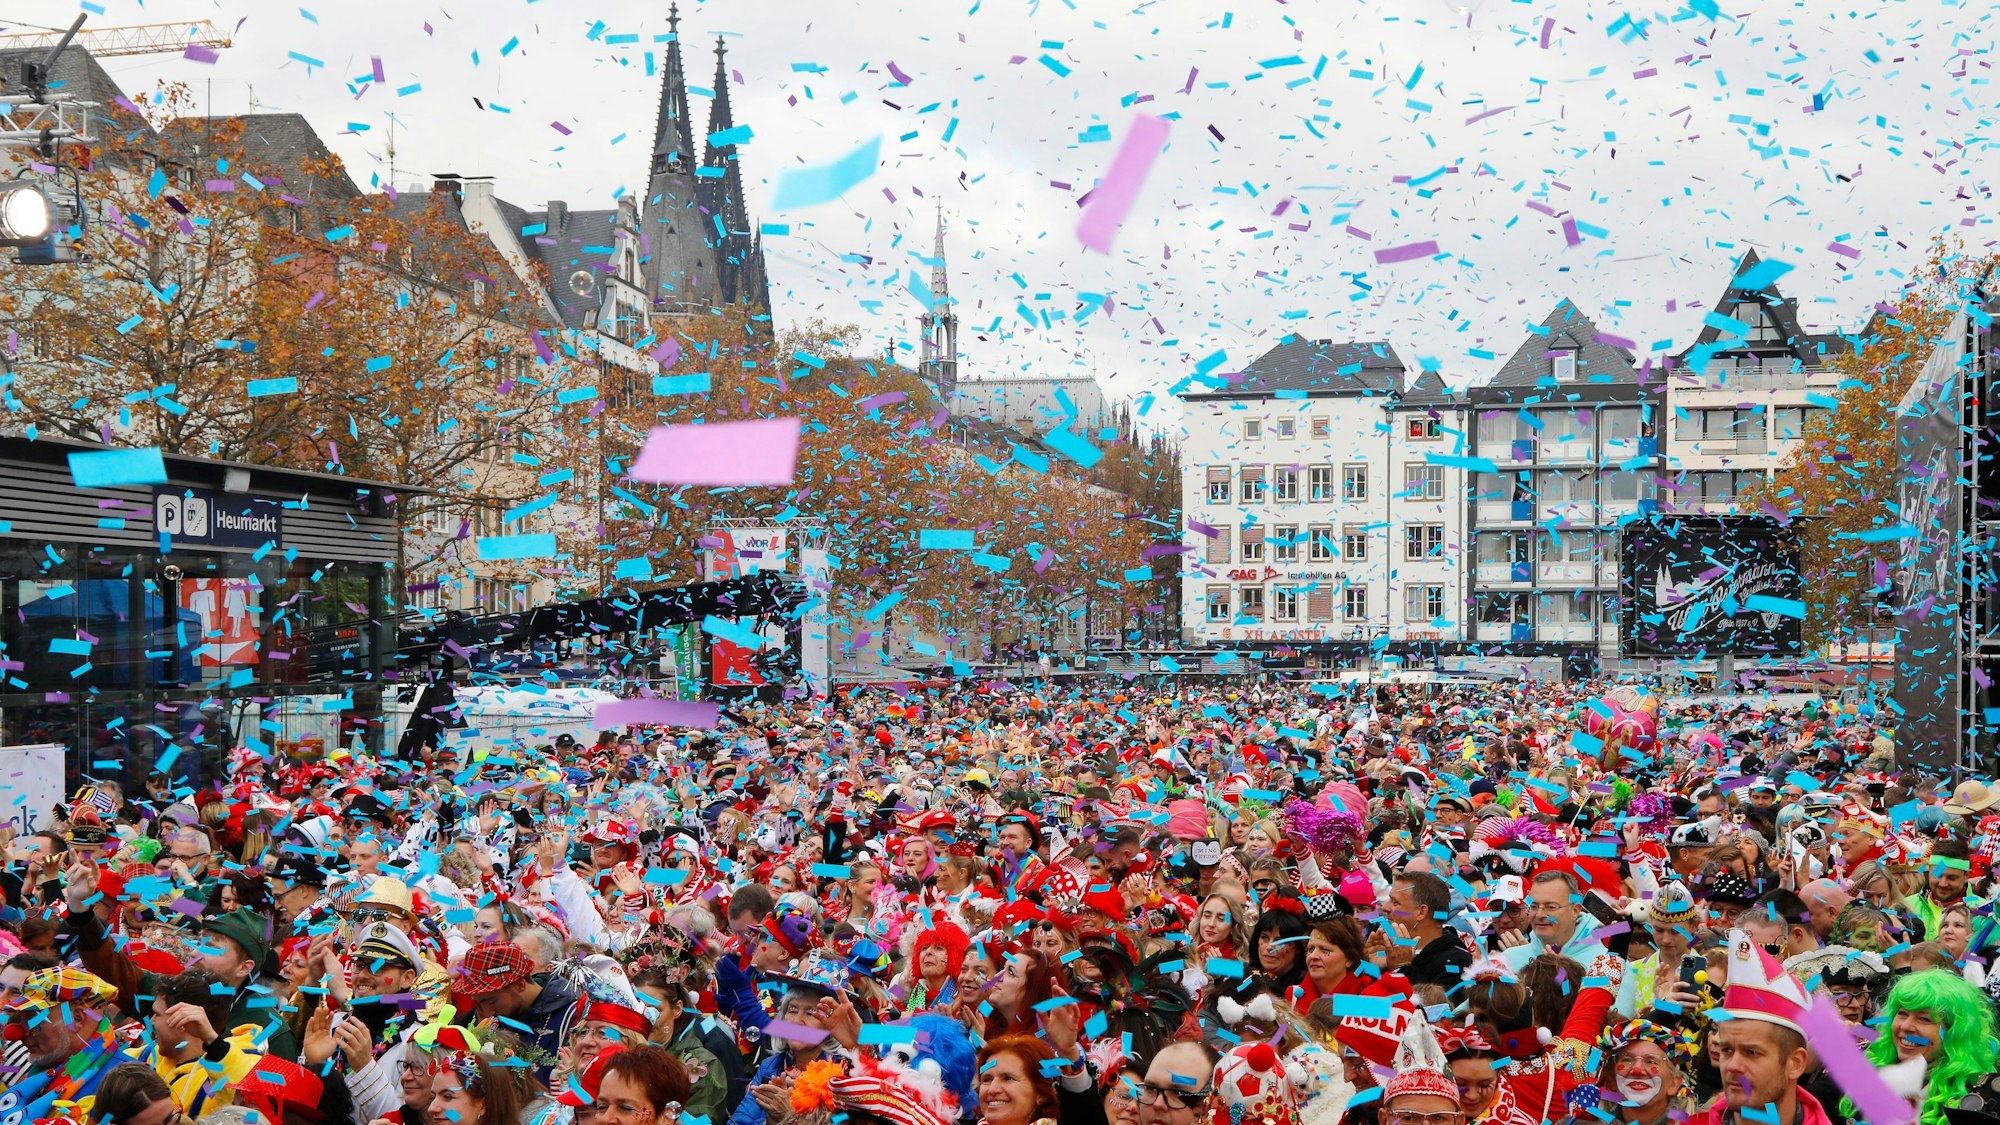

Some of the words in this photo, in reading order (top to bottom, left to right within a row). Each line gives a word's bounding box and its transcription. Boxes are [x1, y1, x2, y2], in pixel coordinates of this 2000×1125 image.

[216, 510, 277, 533] Heumarkt
[746, 539, 769, 548] WDR
[1230, 569, 1257, 580] GAG
[1334, 571, 1347, 580] AG
[1406, 631, 1443, 641] HOTEL
[487, 965, 510, 975] BRINGS
